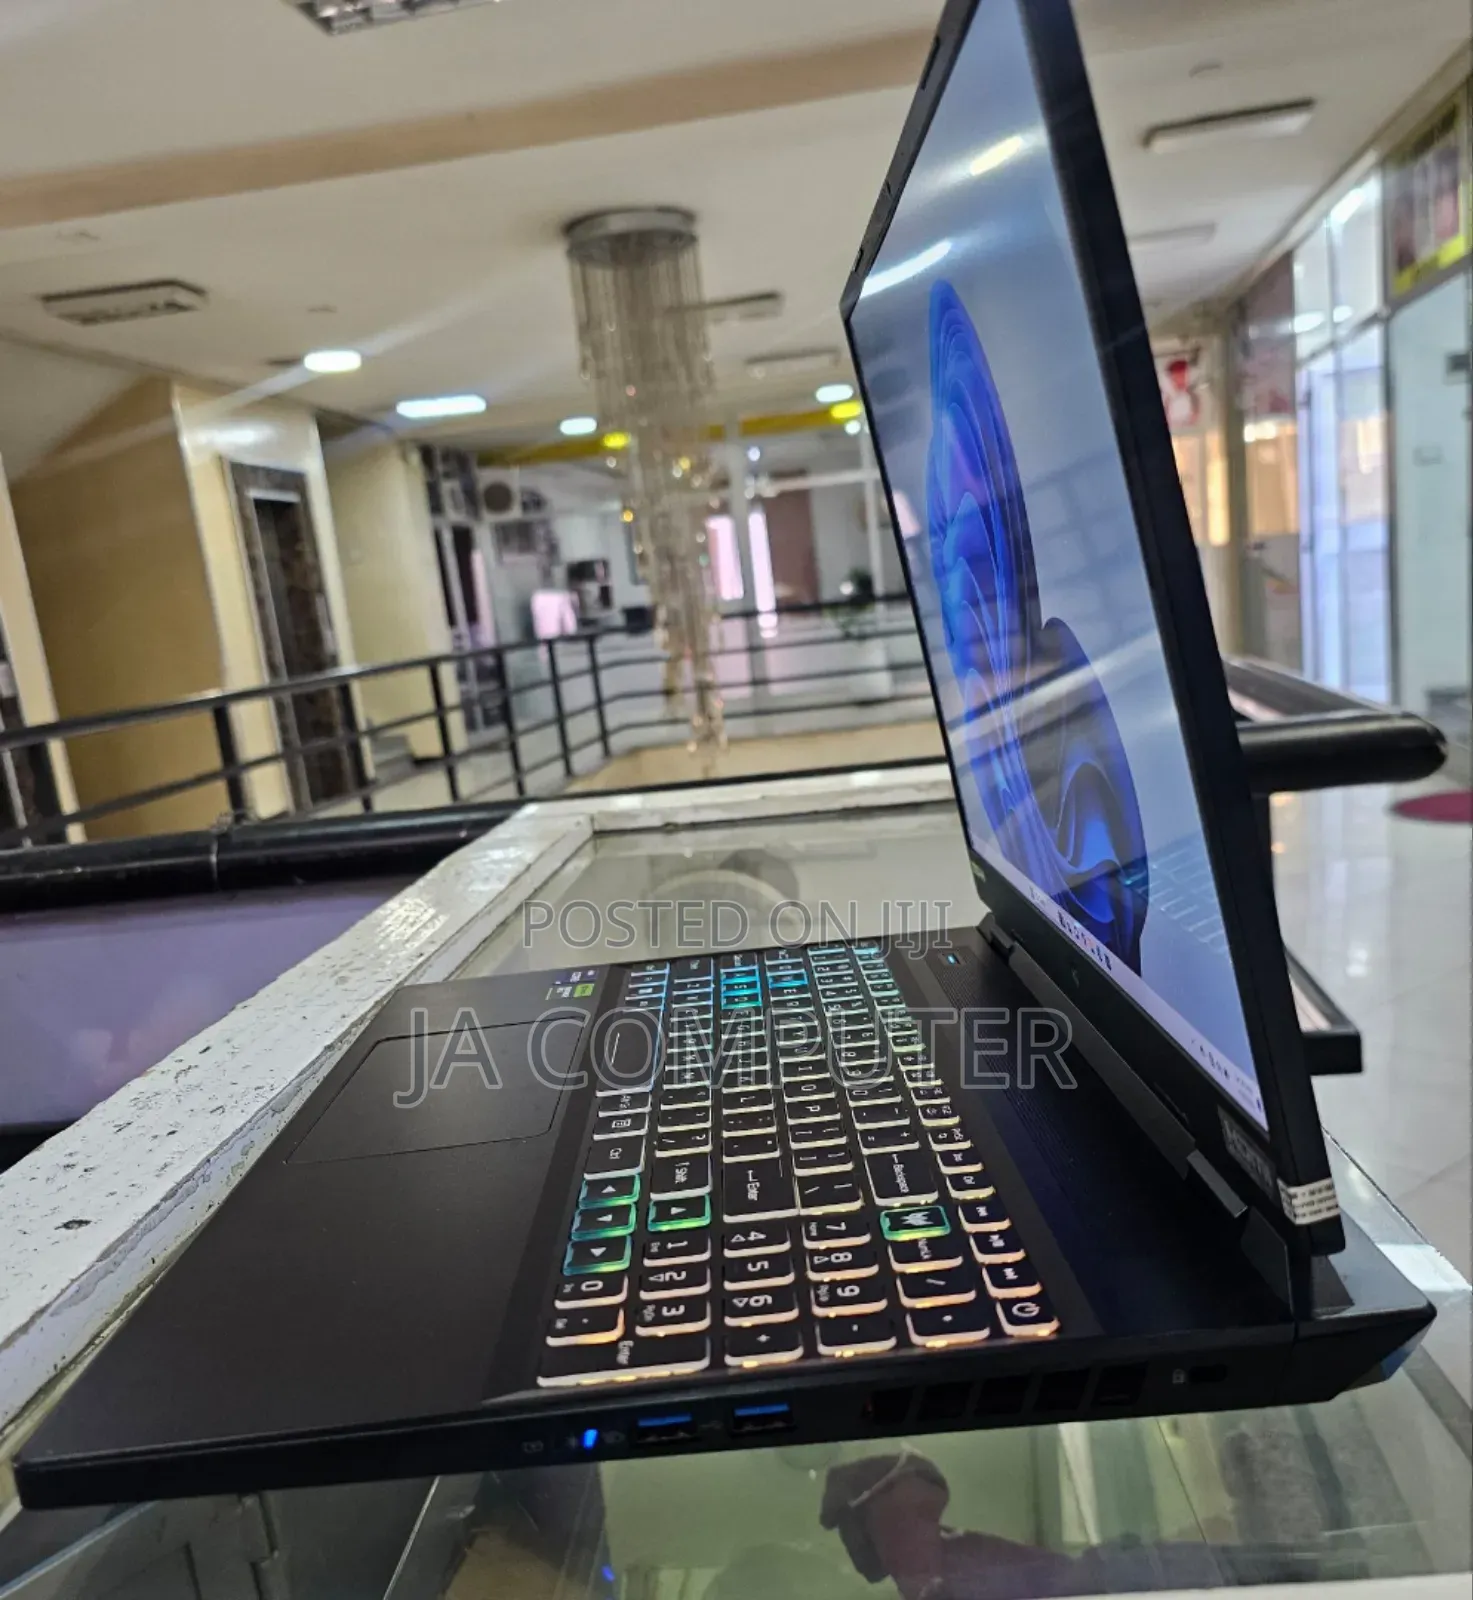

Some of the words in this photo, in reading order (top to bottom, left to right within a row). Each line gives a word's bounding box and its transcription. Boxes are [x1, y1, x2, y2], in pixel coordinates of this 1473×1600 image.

[740, 1095, 757, 1104] L
[804, 1104, 822, 1113] P
[675, 1167, 688, 1185] Shift
[892, 1163, 911, 1194] Backspace
[746, 1181, 760, 1202] Enter
[825, 1221, 848, 1233] 7
[747, 1230, 768, 1242] 4
[666, 1240, 689, 1250] 1
[830, 1251, 853, 1264] 8
[747, 1259, 770, 1273] 5
[664, 1270, 687, 1282] 2
[580, 1279, 604, 1293] 0
[836, 1284, 861, 1298] 9
[748, 1294, 774, 1308] 6
[661, 1304, 686, 1318] 3
[616, 1339, 635, 1366] Enter
